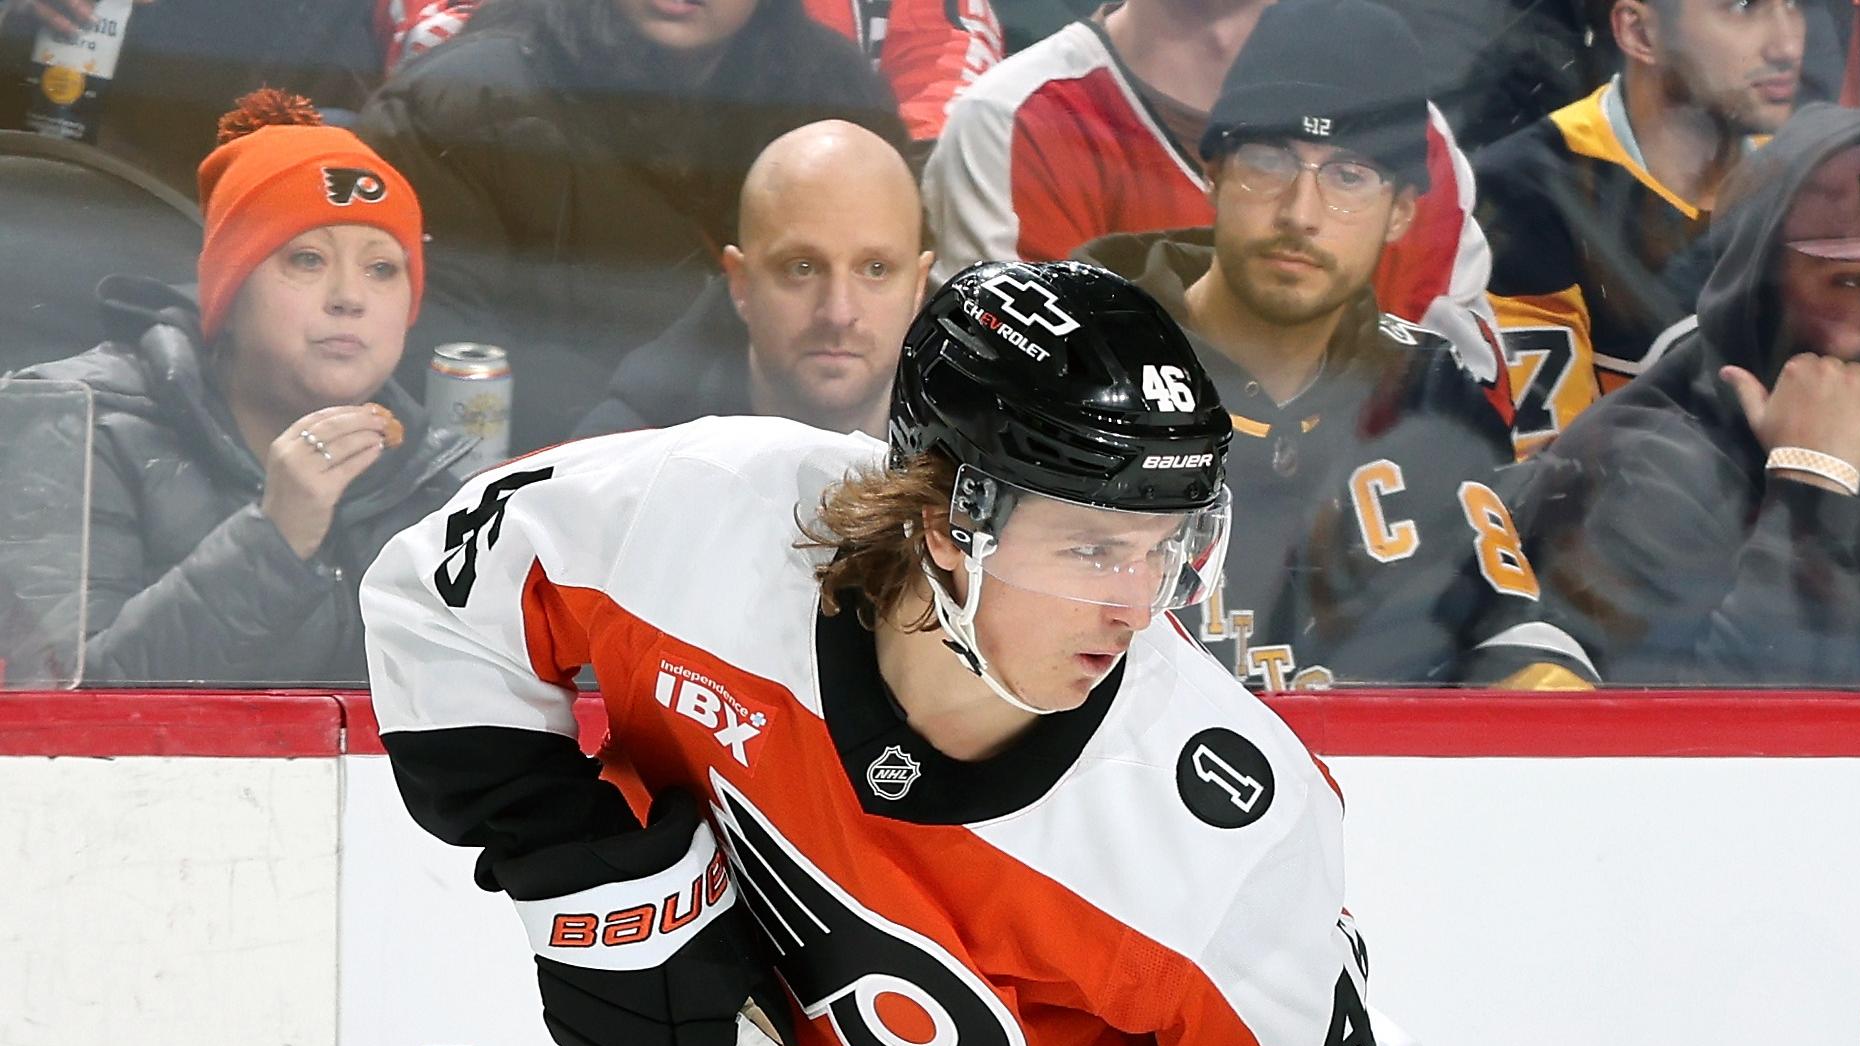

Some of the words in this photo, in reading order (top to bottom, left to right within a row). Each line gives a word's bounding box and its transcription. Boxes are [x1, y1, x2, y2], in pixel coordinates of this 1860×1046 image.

[962, 299, 1051, 363] CHEVROLET
[1141, 364, 1197, 413] 46
[1141, 452, 1214, 469] BAUER
[434, 466, 555, 609] 46
[1348, 458, 1421, 564] C
[654, 670, 762, 769] IBX
[659, 659, 750, 718] Independence
[874, 769, 909, 780] NHL
[1192, 743, 1264, 814] 1
[548, 850, 731, 948] BAUE
